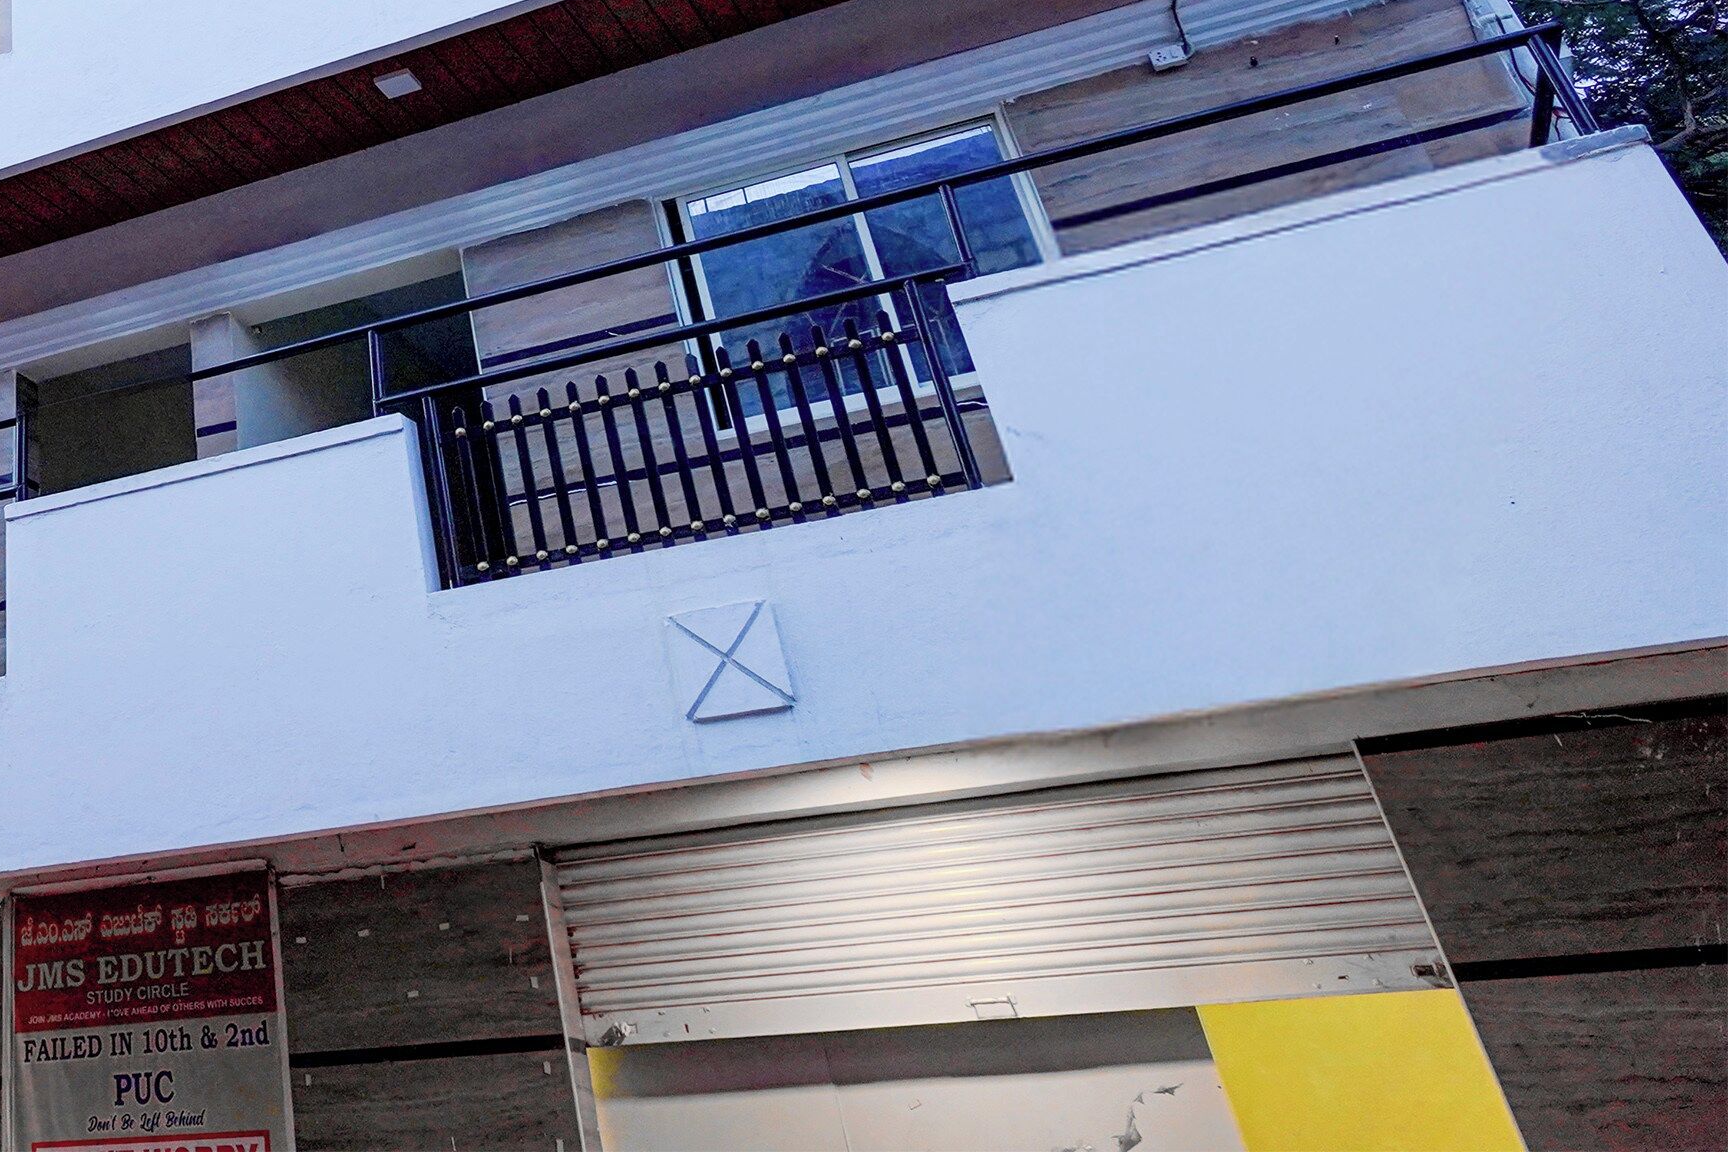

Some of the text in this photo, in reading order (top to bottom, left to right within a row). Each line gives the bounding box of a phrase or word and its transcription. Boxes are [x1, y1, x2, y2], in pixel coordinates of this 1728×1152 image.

[17, 940, 267, 993] JMS EDUTECH
[87, 982, 189, 1004] STUDY CIRCLE
[63, 1011, 101, 1022] ACADEMY
[131, 1005, 158, 1015] AHEAD
[160, 1004, 171, 1013] OF
[172, 1000, 204, 1012] OTHERS
[206, 998, 228, 1009] WITH
[23, 1020, 270, 1063] FAILED IN 10th & 2nd
[114, 1070, 174, 1106] PUC
[121, 1113, 135, 1130] Be
[165, 1109, 206, 1127] Behind
